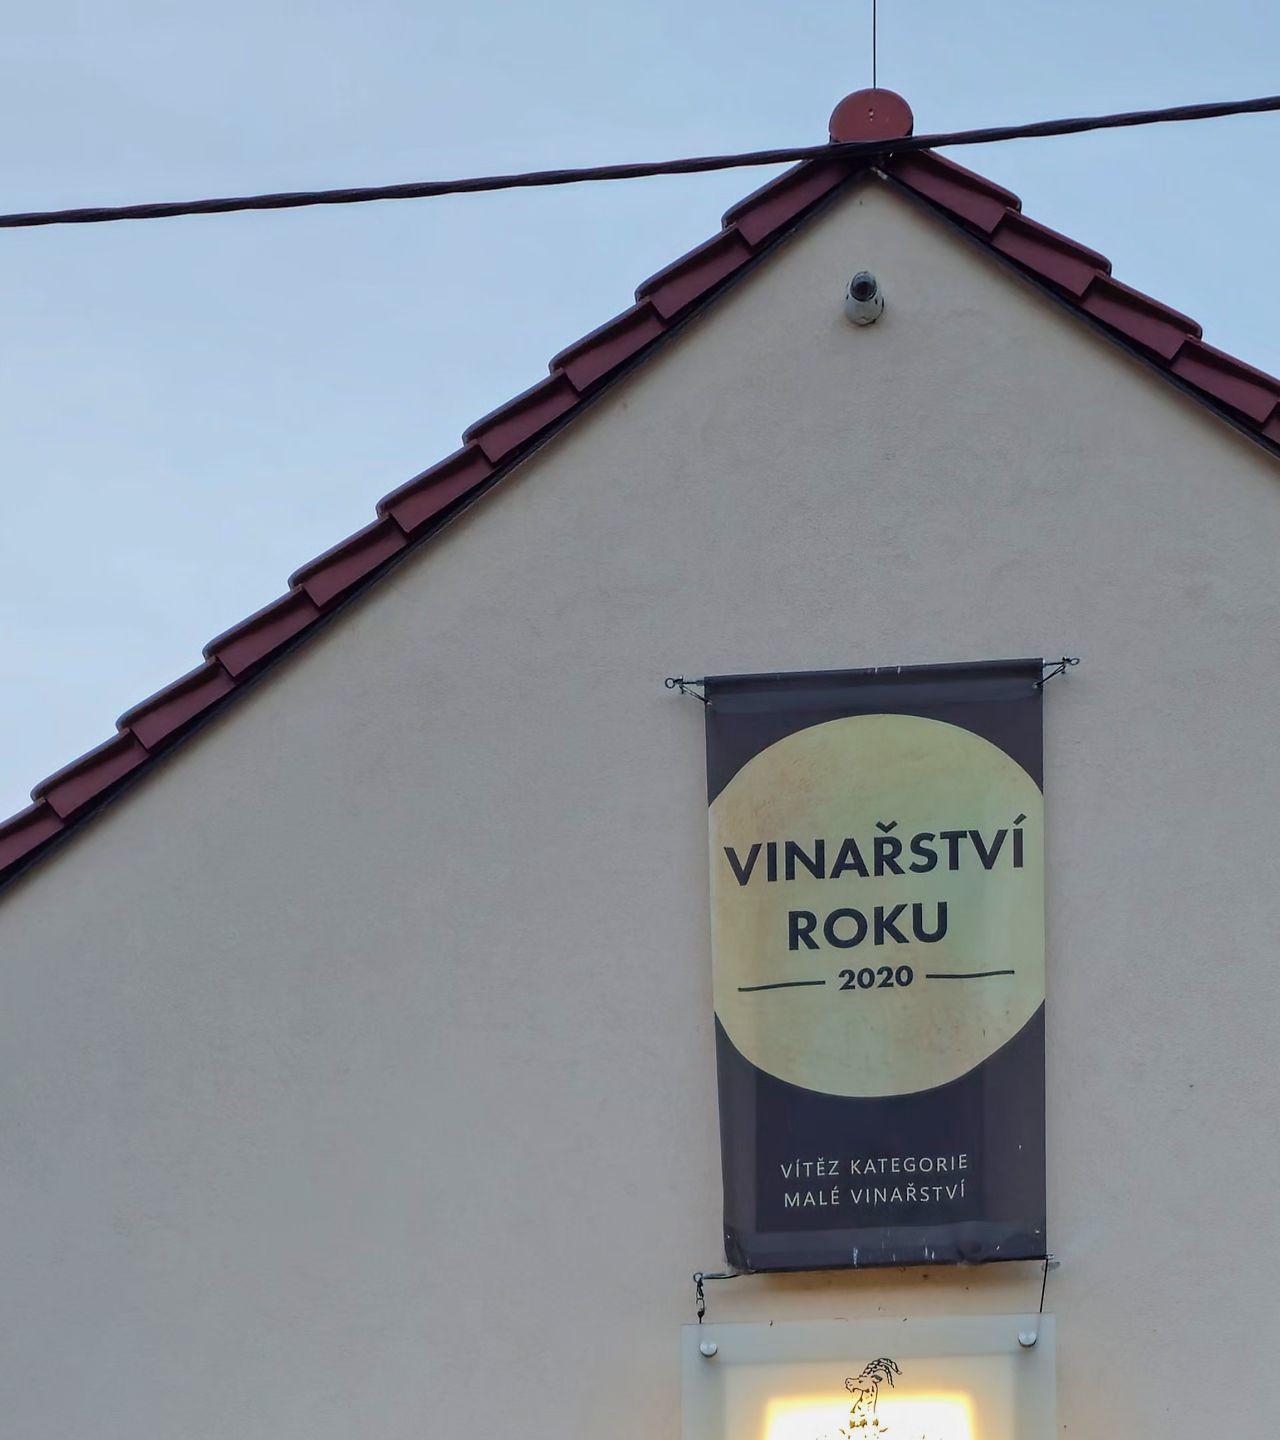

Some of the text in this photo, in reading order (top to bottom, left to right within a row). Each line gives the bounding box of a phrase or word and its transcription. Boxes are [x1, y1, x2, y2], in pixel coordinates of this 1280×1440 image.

[723, 813, 1028, 887] VINAŘSTVÍ
[788, 901, 949, 951] ROKU
[838, 965, 915, 991] 2020
[780, 1154, 968, 1179] VÍTĚZ KATEGORIE
[784, 1178, 966, 1208] MALÉ VINAŘSTVÍ
